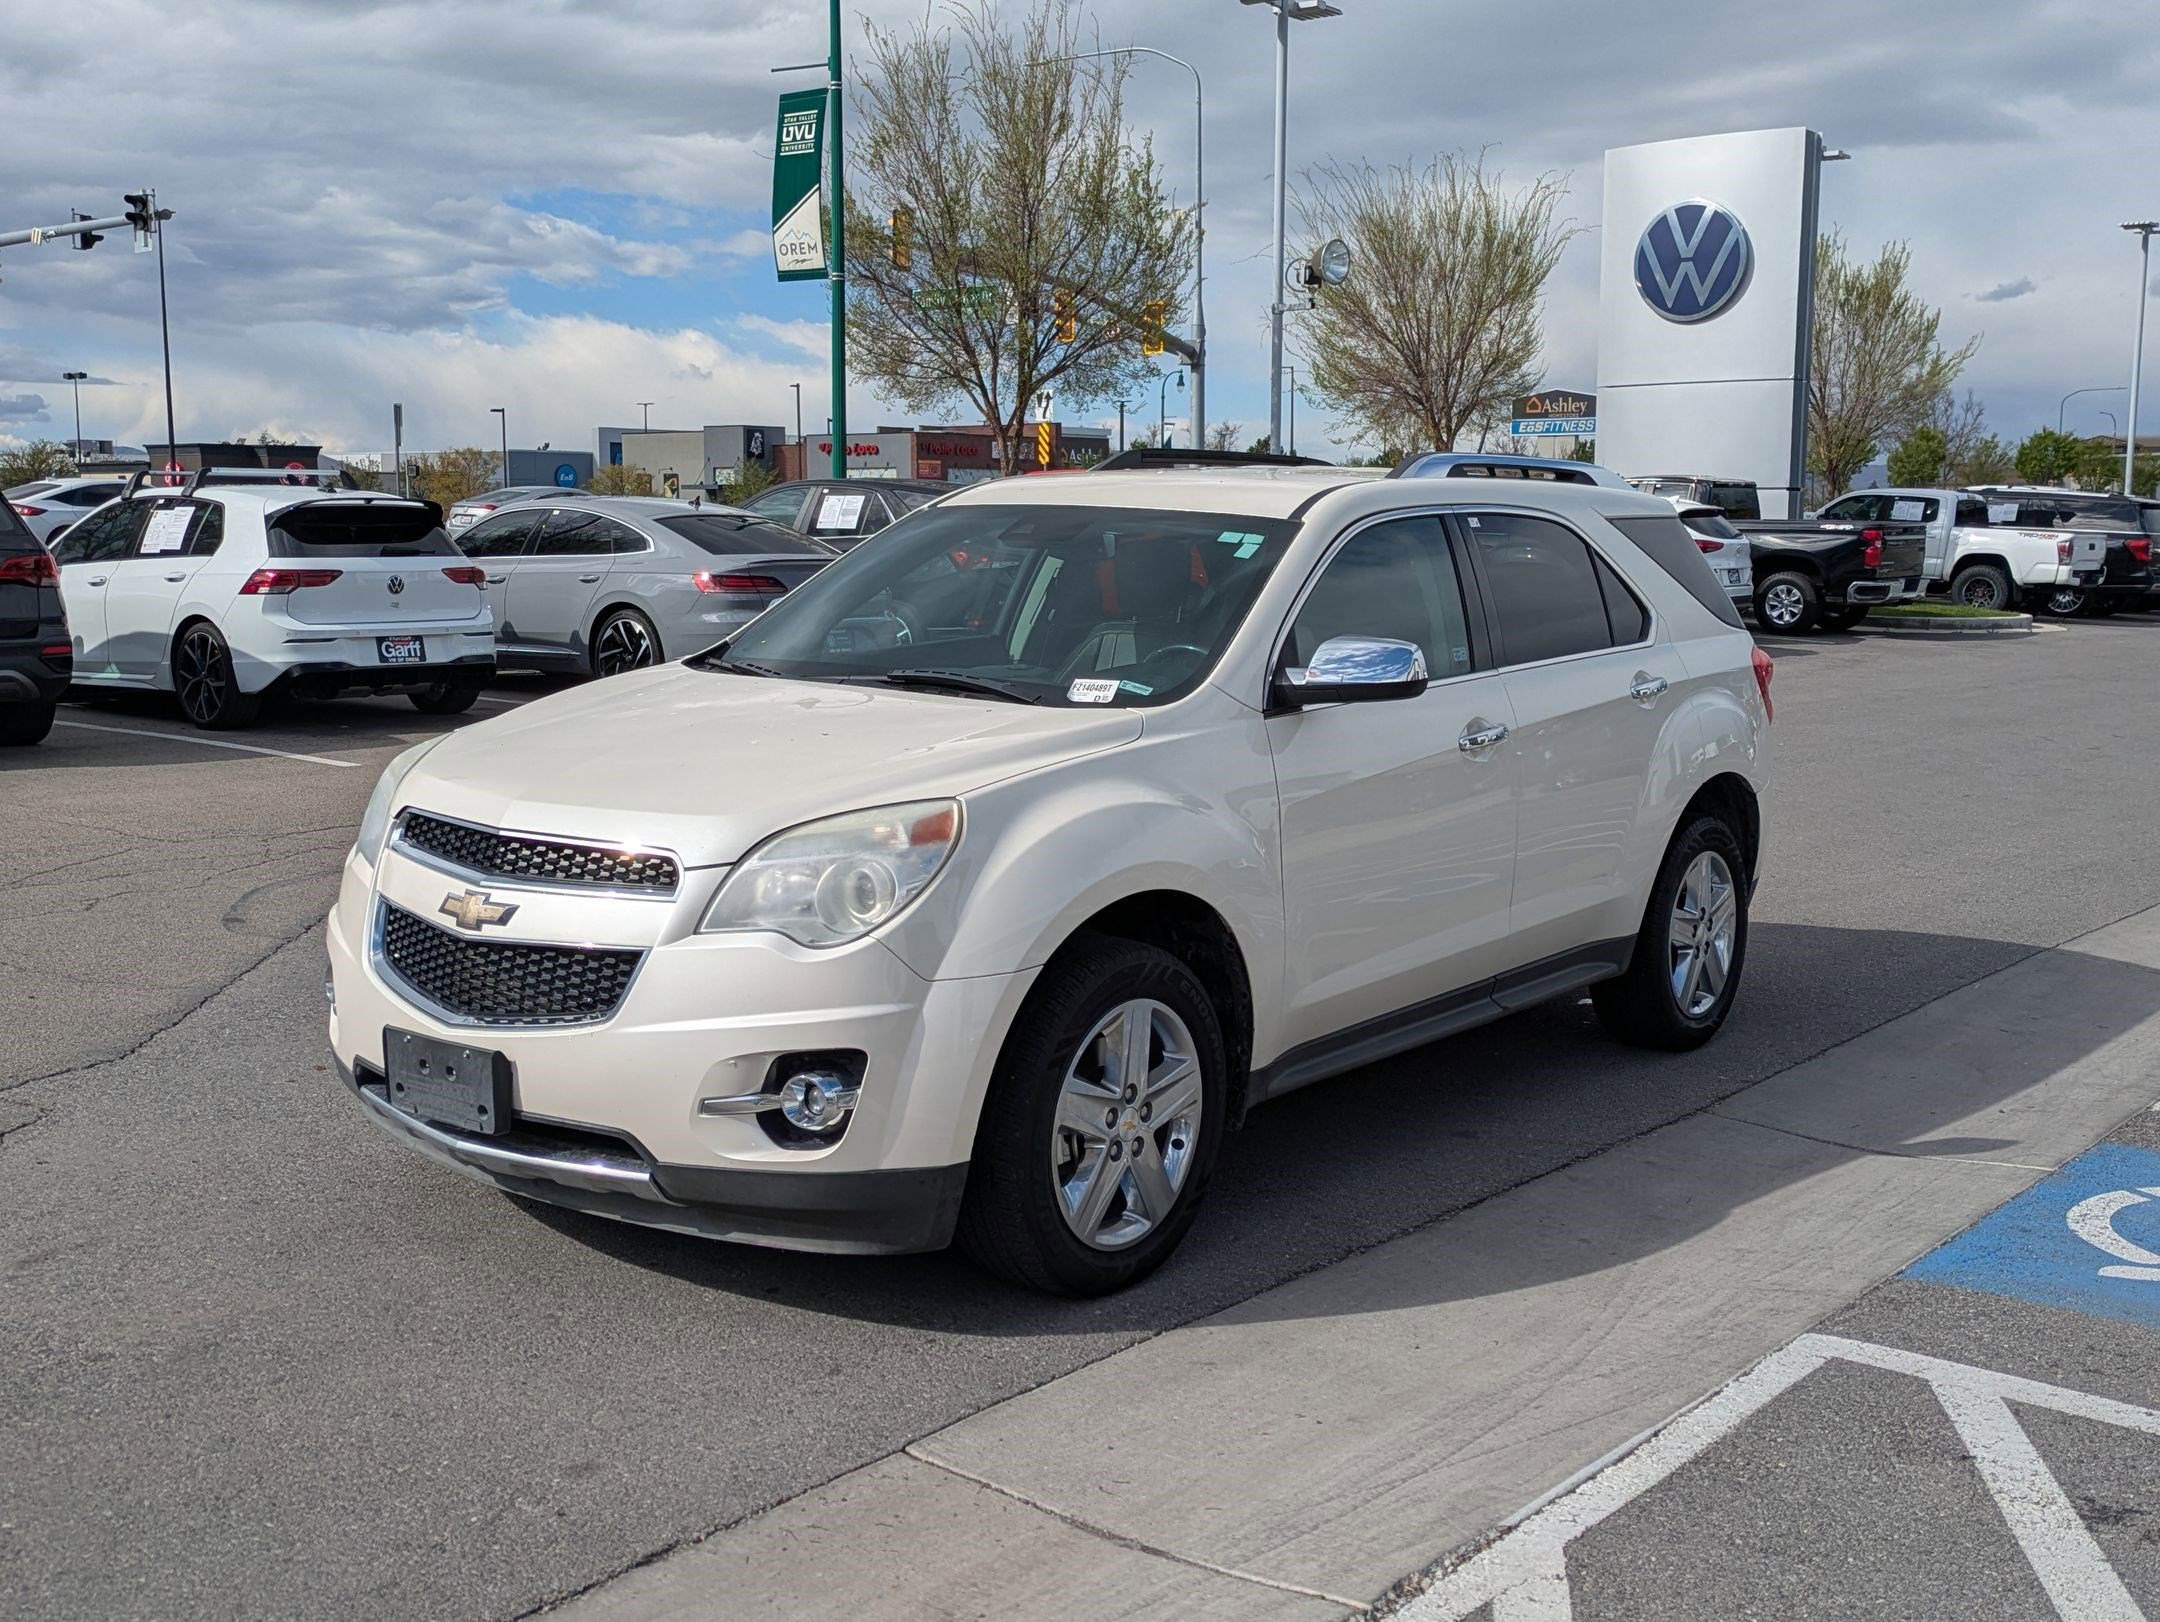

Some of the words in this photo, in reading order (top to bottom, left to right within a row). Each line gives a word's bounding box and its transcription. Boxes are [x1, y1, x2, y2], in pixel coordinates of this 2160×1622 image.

[783, 123, 816, 142] UVU
[781, 143, 814, 152] UNIVERSITY
[779, 241, 818, 256] OREM
[1541, 397, 1587, 415] Ashley
[381, 641, 421, 658] Garff
